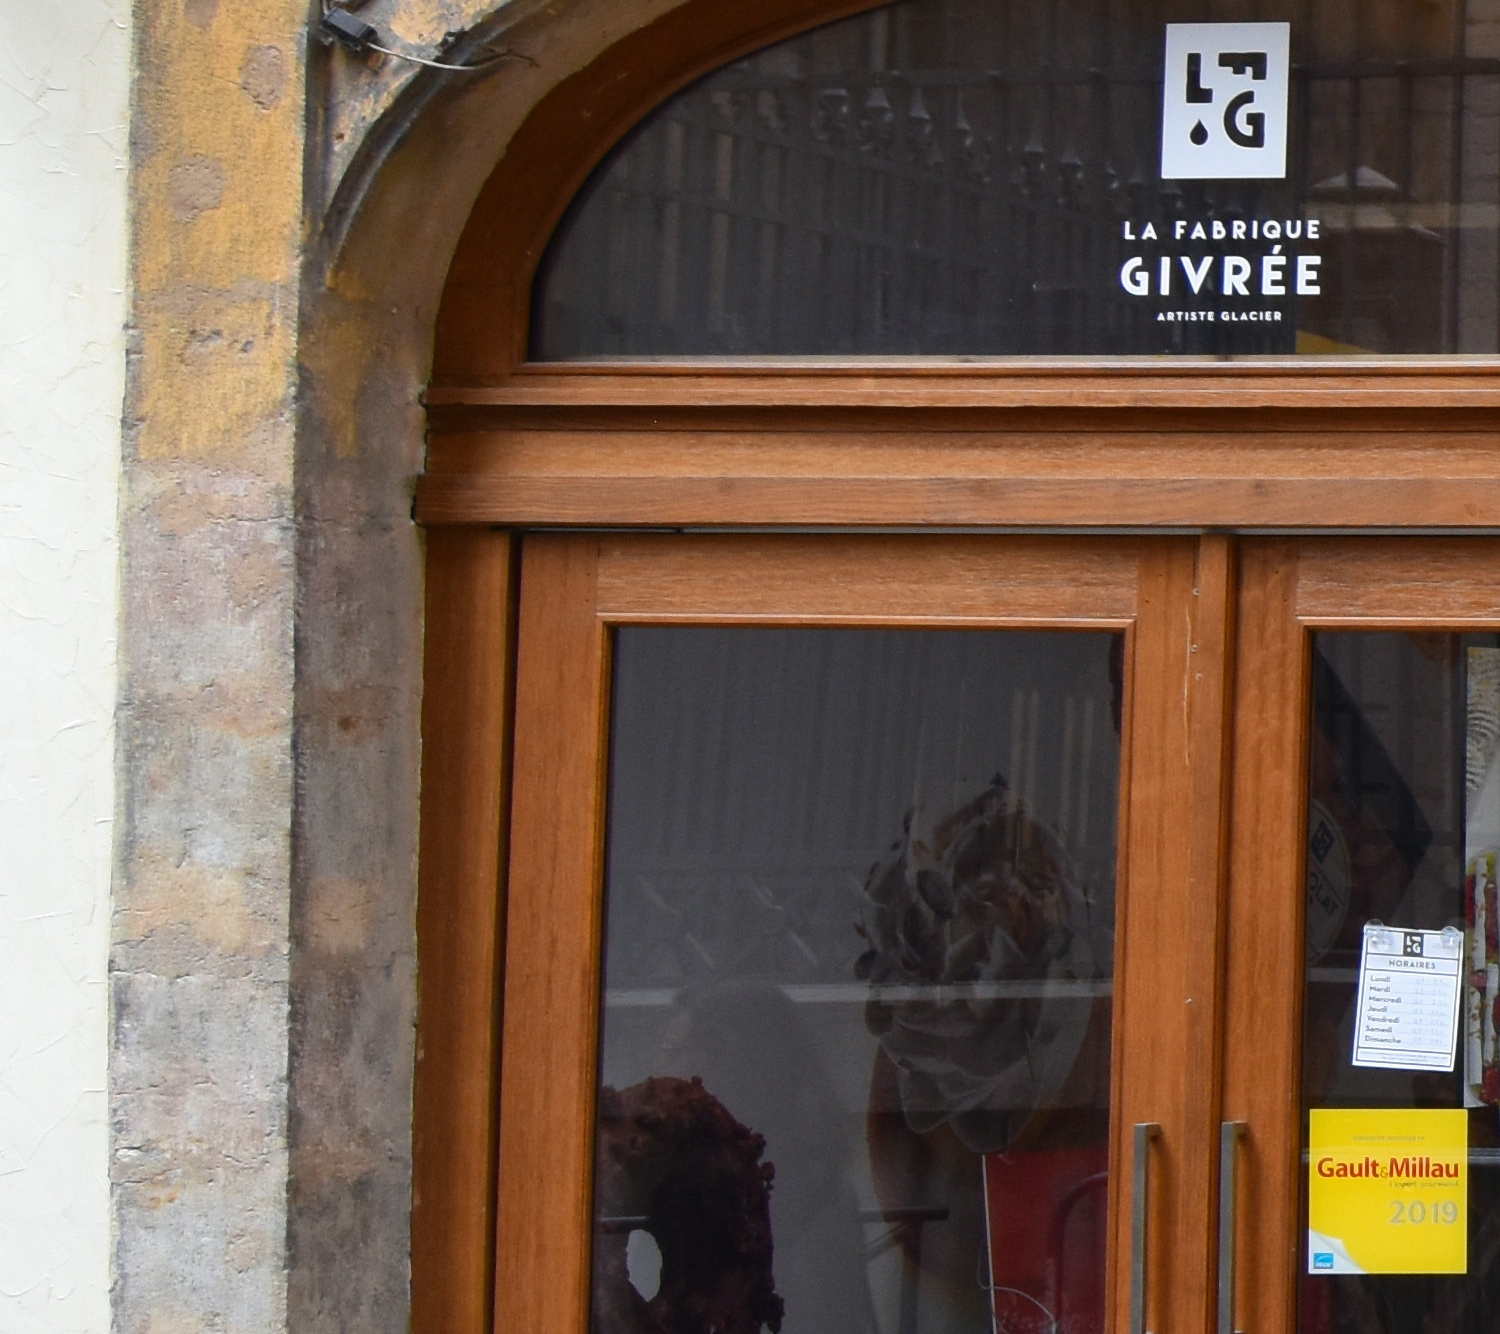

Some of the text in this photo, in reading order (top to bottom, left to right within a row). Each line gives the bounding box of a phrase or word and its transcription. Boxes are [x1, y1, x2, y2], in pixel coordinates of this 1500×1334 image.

[1123, 219, 1321, 241] LA FABRIQUE
[1120, 245, 1322, 297] GIVRÉE
[1157, 310, 1283, 322] ARTISTE GLACIER
[1388, 958, 1436, 970] HORAIRES
[1317, 1156, 1459, 1179] Gault&Millau
[1389, 1199, 1459, 1225] 2019
